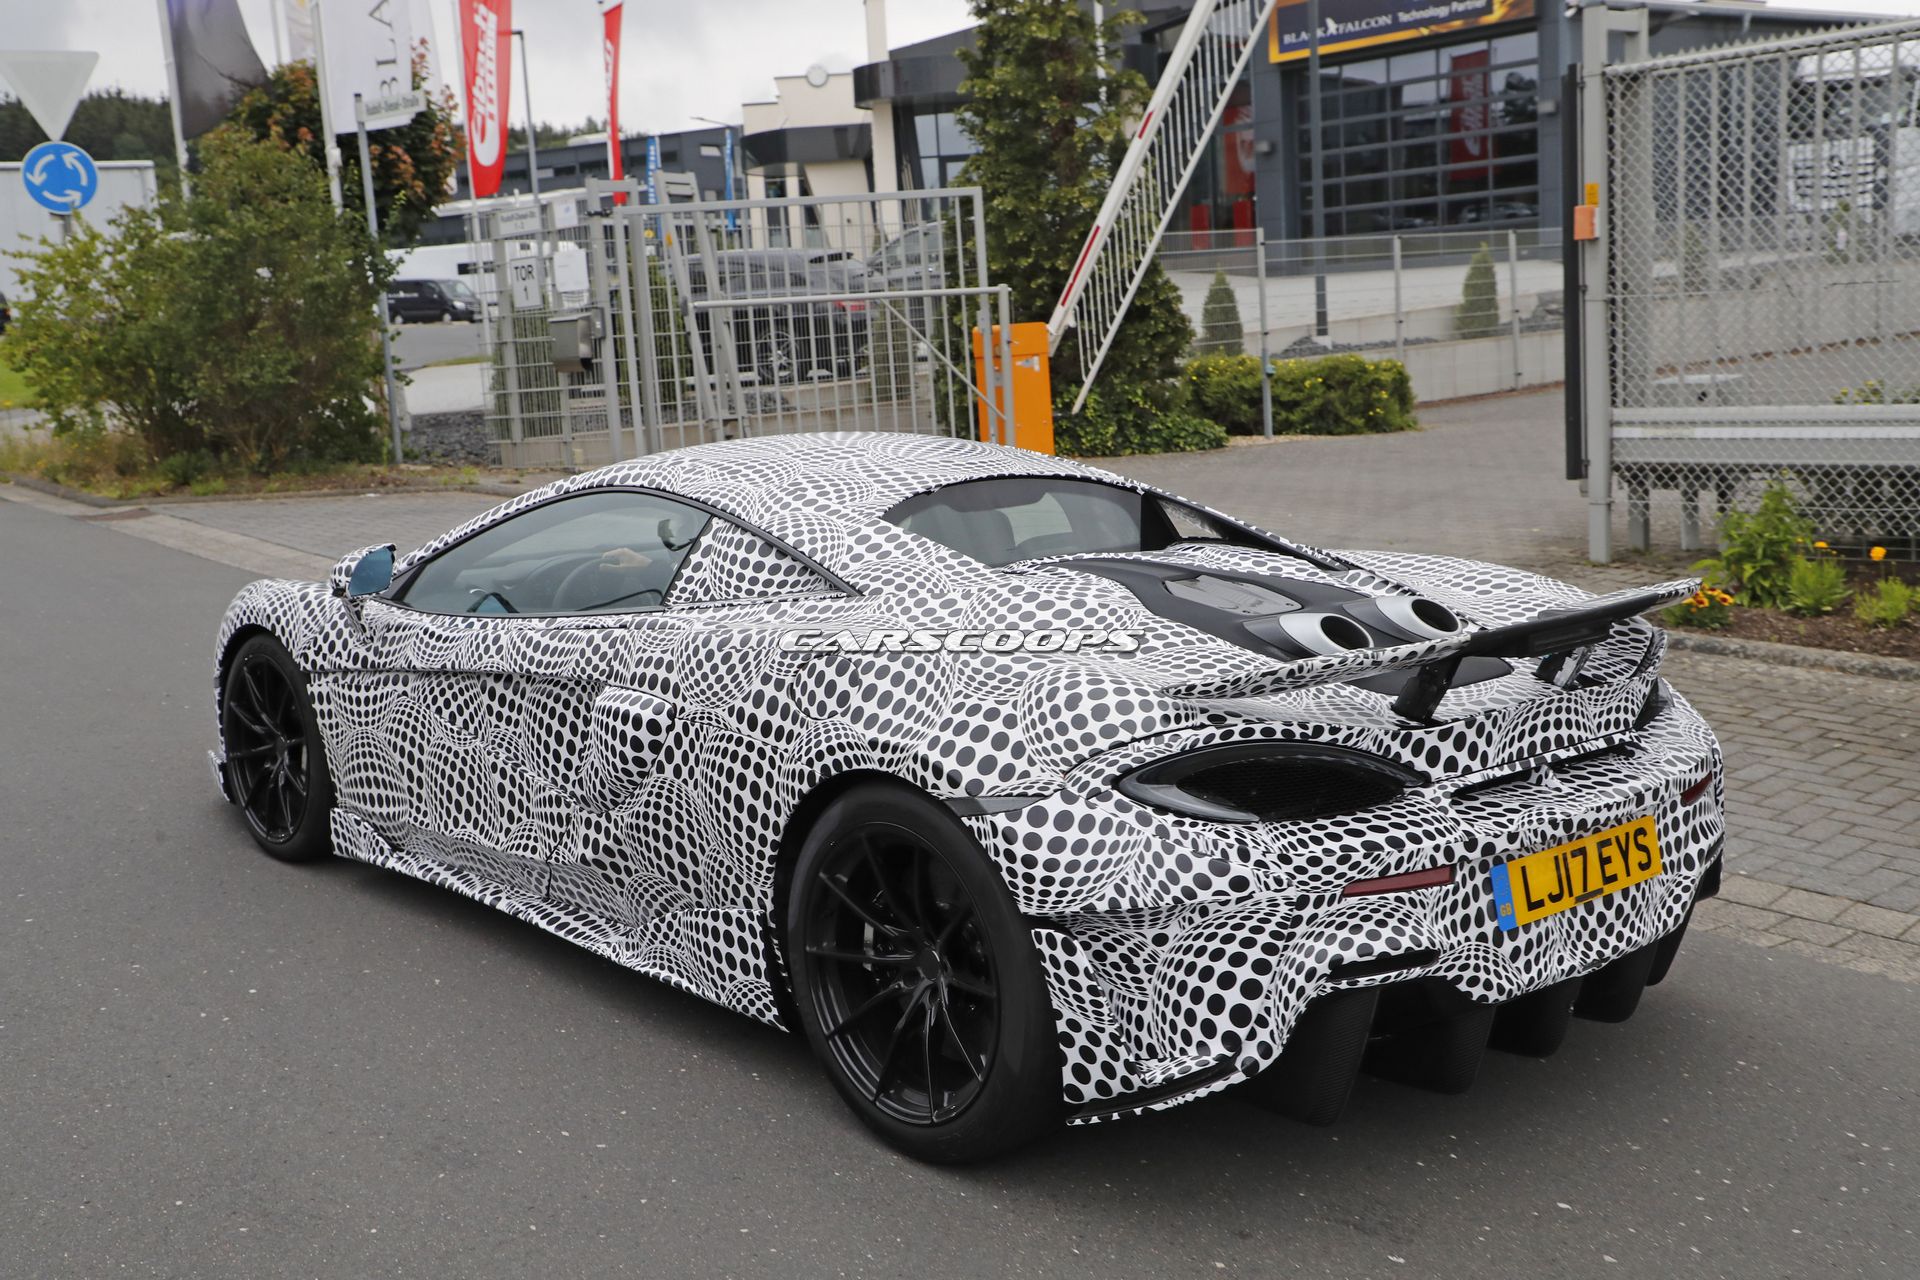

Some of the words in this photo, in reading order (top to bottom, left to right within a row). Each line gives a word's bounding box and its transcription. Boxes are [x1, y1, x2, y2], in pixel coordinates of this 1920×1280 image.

[1398, 5, 1450, 22] Technology
[1451, 0, 1487, 12] Partner
[1283, 27, 1327, 45] BLAK
[1336, 14, 1393, 35] FALCON
[514, 265, 535, 280] TOR
[523, 286, 529, 300] 1
[1500, 903, 1512, 917] GB
